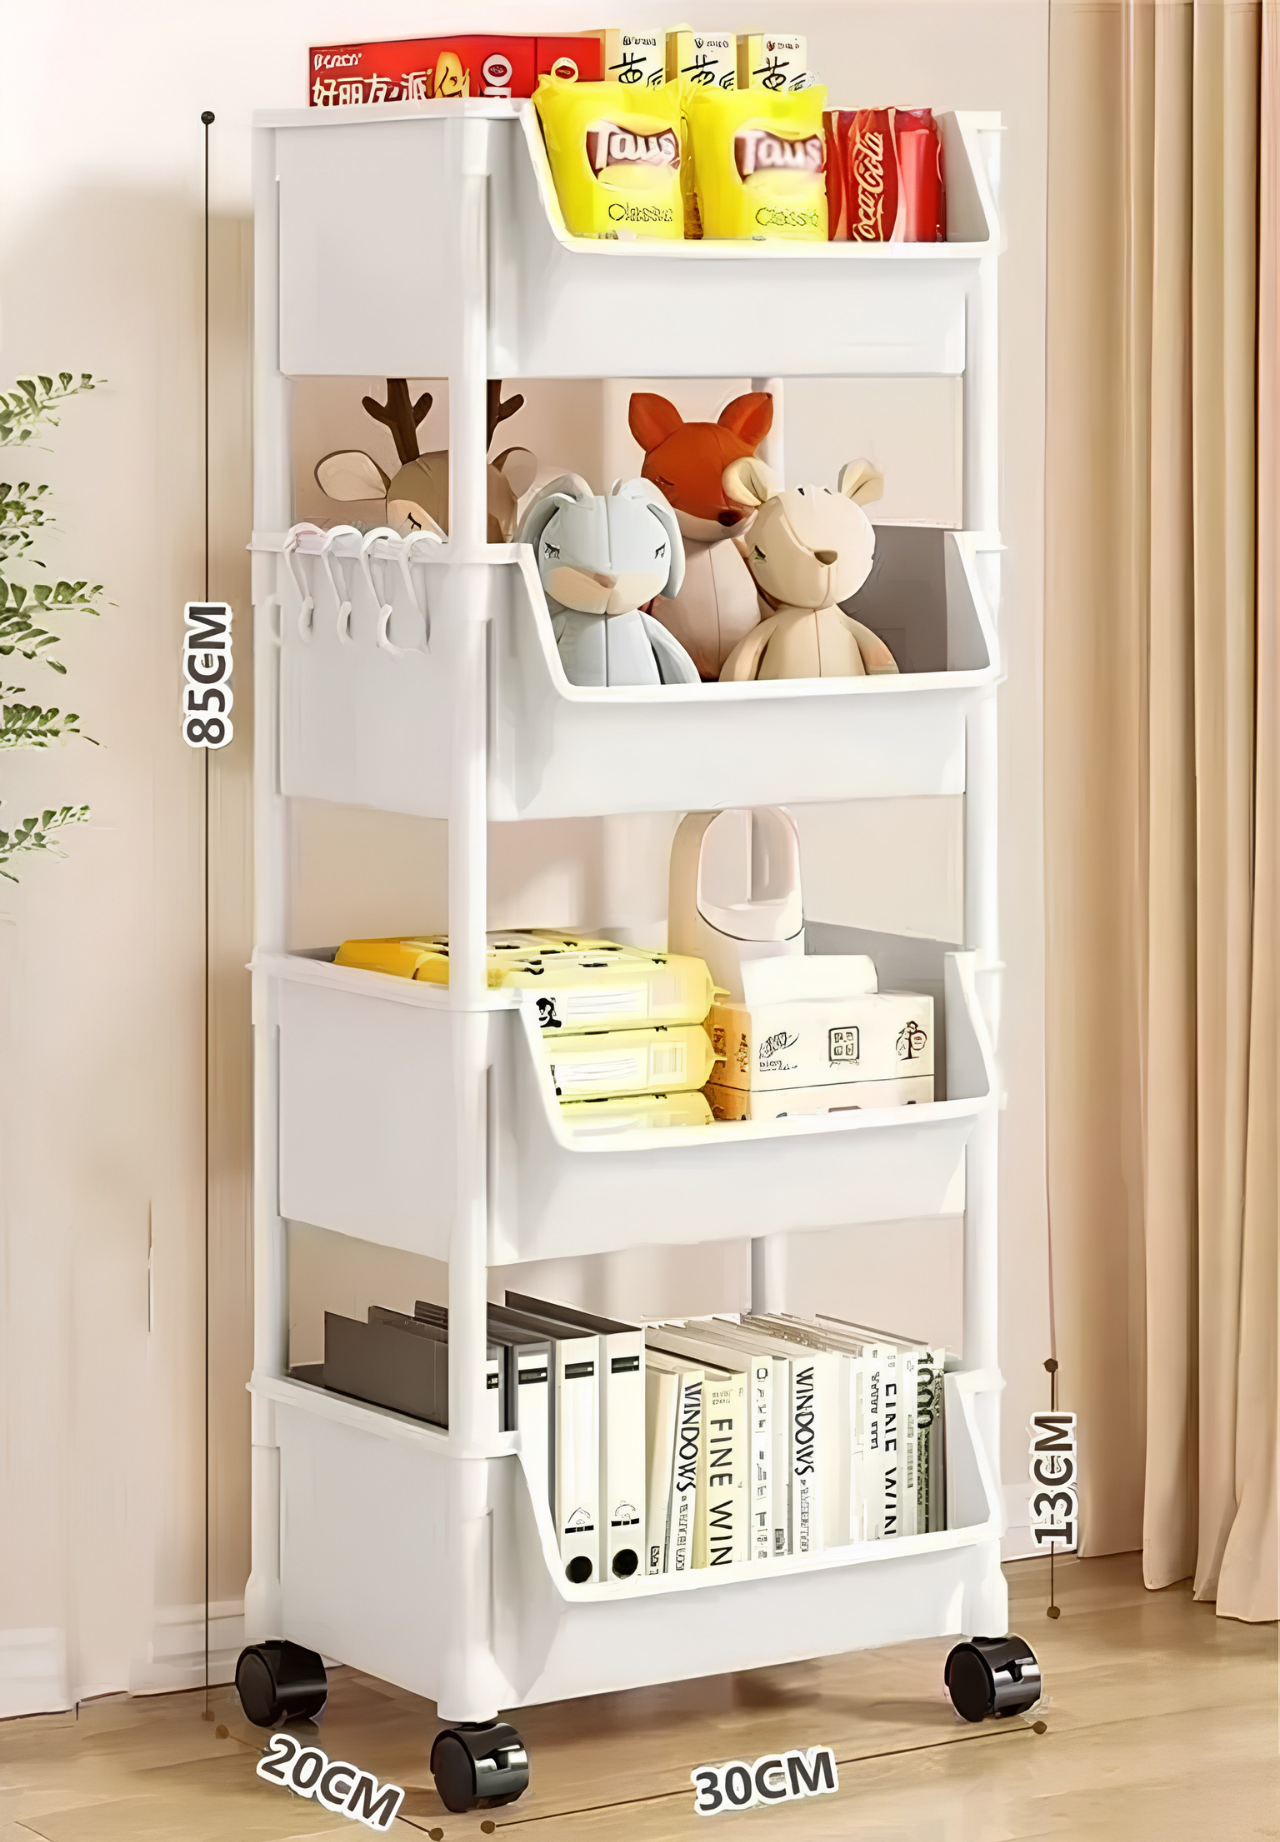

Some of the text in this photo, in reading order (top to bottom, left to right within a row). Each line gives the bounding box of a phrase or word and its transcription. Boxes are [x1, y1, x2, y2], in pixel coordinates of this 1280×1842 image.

[676, 1381, 703, 1493] WINDOWS
[709, 1418, 734, 1488] FINE
[794, 1366, 815, 1477] WINDOWS
[709, 1499, 734, 1567] WIN
